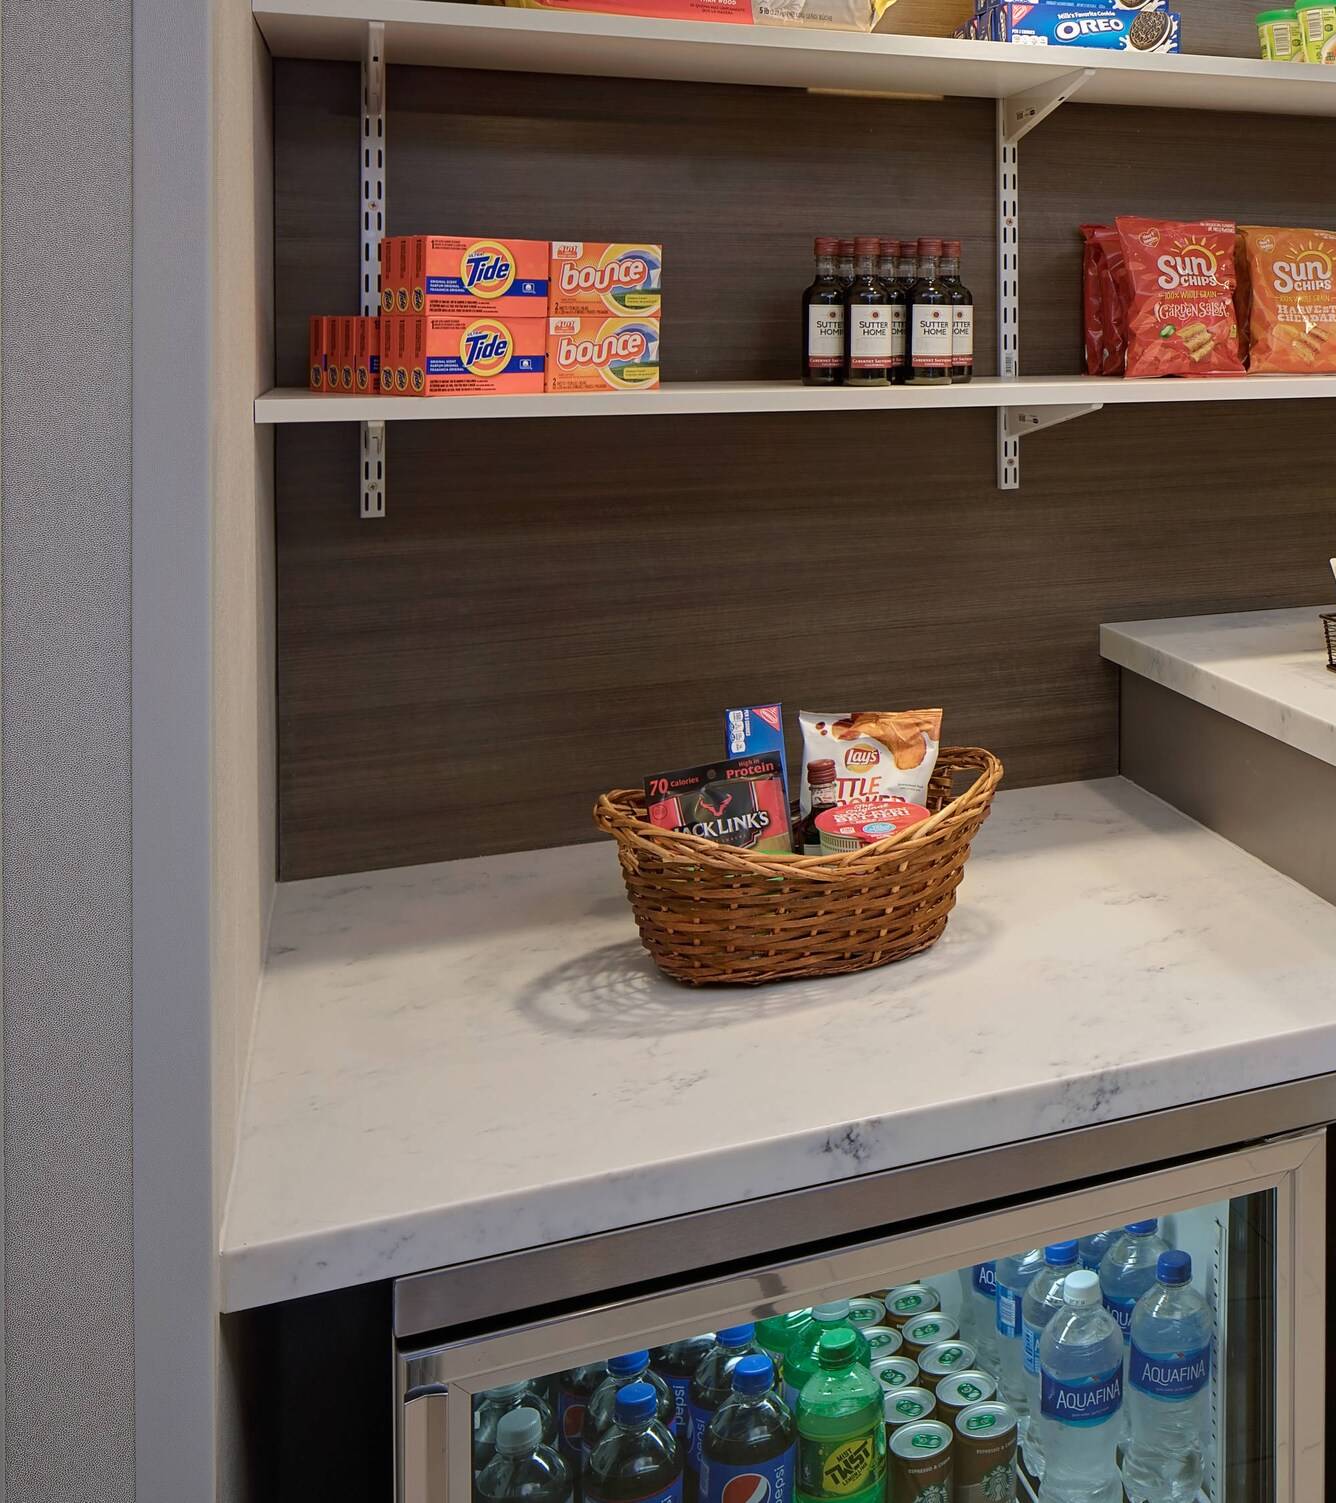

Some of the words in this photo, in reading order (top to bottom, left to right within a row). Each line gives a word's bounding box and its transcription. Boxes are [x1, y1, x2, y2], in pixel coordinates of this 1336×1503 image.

[1056, 18, 1124, 40] OREO
[466, 256, 510, 288] Tide
[561, 260, 646, 291] bounce
[1157, 254, 1217, 290] Sun
[1180, 275, 1217, 287] CHIPS
[1272, 260, 1332, 293] Sun
[1294, 280, 1332, 291] CHIPS
[1277, 304, 1336, 314] HARVEST
[816, 320, 844, 328] SUTTE
[858, 320, 888, 328] SUTTER
[862, 328, 886, 336] HOME
[920, 320, 948, 328] SUTTER
[923, 328, 947, 336] HOME
[466, 334, 508, 366] Tide
[559, 332, 643, 368] bounce
[738, 760, 753, 768] High
[847, 749, 878, 764] Lay's
[726, 762, 774, 779] Protein
[650, 778, 668, 796] 70
[670, 776, 699, 788] calories
[836, 776, 882, 799] TTLE
[716, 811, 769, 835] LINK'S
[1141, 1360, 1206, 1387] AQUAFINA
[672, 1385, 686, 1426] pepsi
[1056, 1382, 1121, 1410] AQUAFINA
